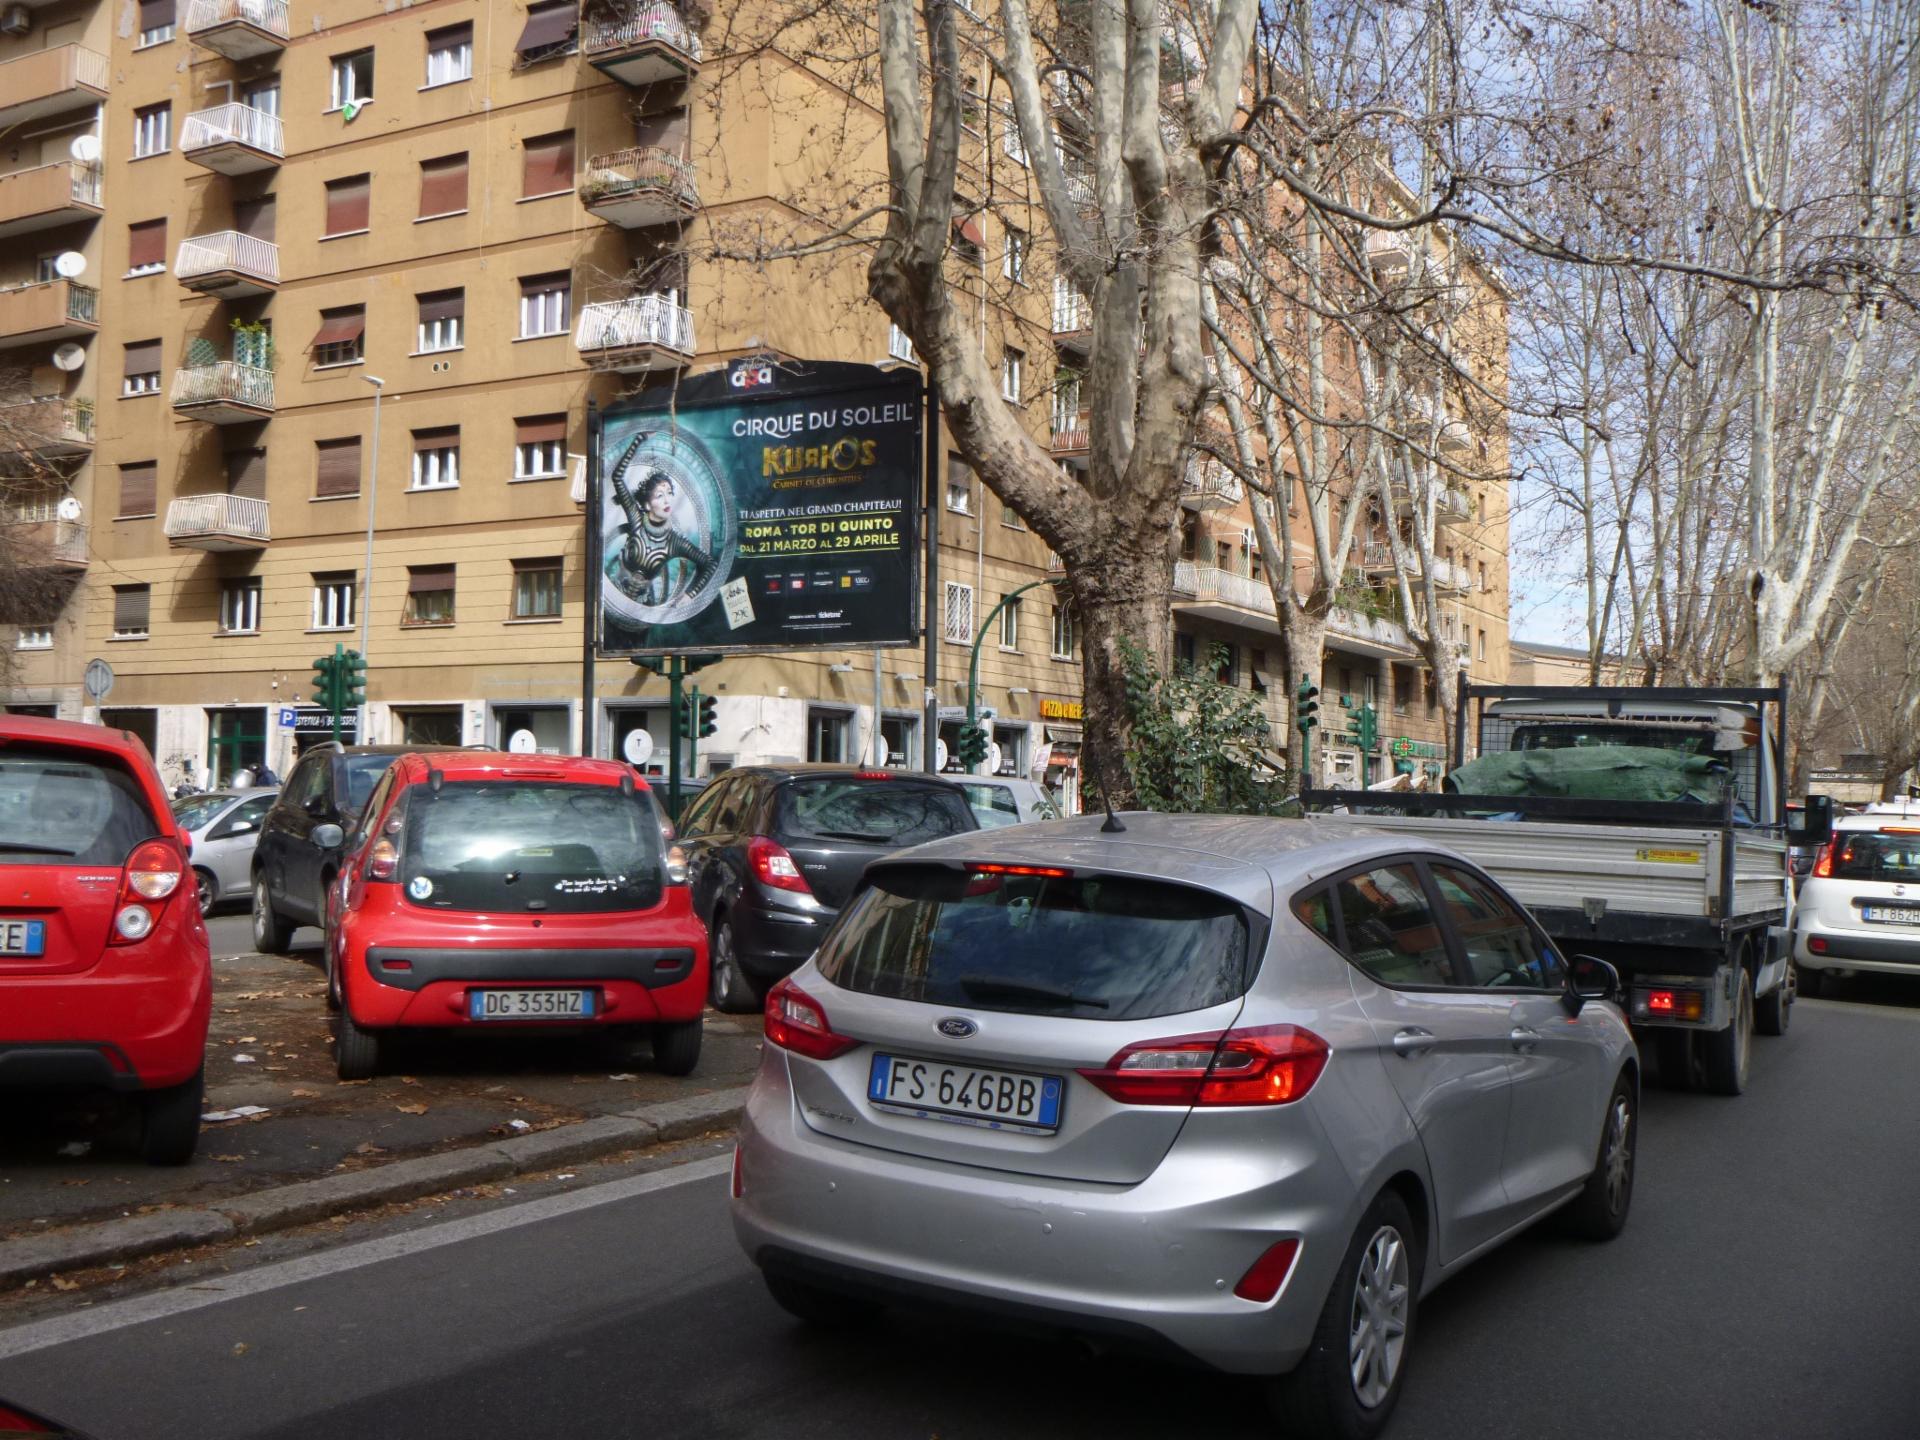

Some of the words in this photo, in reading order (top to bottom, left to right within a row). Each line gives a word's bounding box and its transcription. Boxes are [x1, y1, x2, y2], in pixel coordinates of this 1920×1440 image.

[732, 414, 803, 439] CIRQUE
[809, 410, 836, 430] DU
[842, 403, 913, 426] SOLEIL
[740, 509, 749, 519] TI
[749, 507, 786, 519] ASPETTA
[788, 506, 806, 517] NEL
[807, 503, 842, 515] GRAND
[843, 499, 902, 513] CHAPITEAU!
[745, 524, 782, 538] ROMA
[790, 523, 817, 535] TOR
[821, 520, 835, 533] DI
[839, 517, 893, 533] QUINTO
[740, 543, 756, 553] DAL
[759, 541, 771, 553] 21
[774, 538, 817, 551] MARZO
[820, 539, 833, 549] AL
[836, 536, 850, 548] 29
[854, 532, 899, 546] APRILE
[282, 711, 293, 725] P
[1043, 699, 1063, 717] PIZZA
[486, 993, 510, 1014] DG
[518, 992, 580, 1013] 353HZ
[943, 1020, 968, 1034] Ford
[890, 1061, 927, 1100] FS
[938, 1069, 1036, 1116] 646BB
